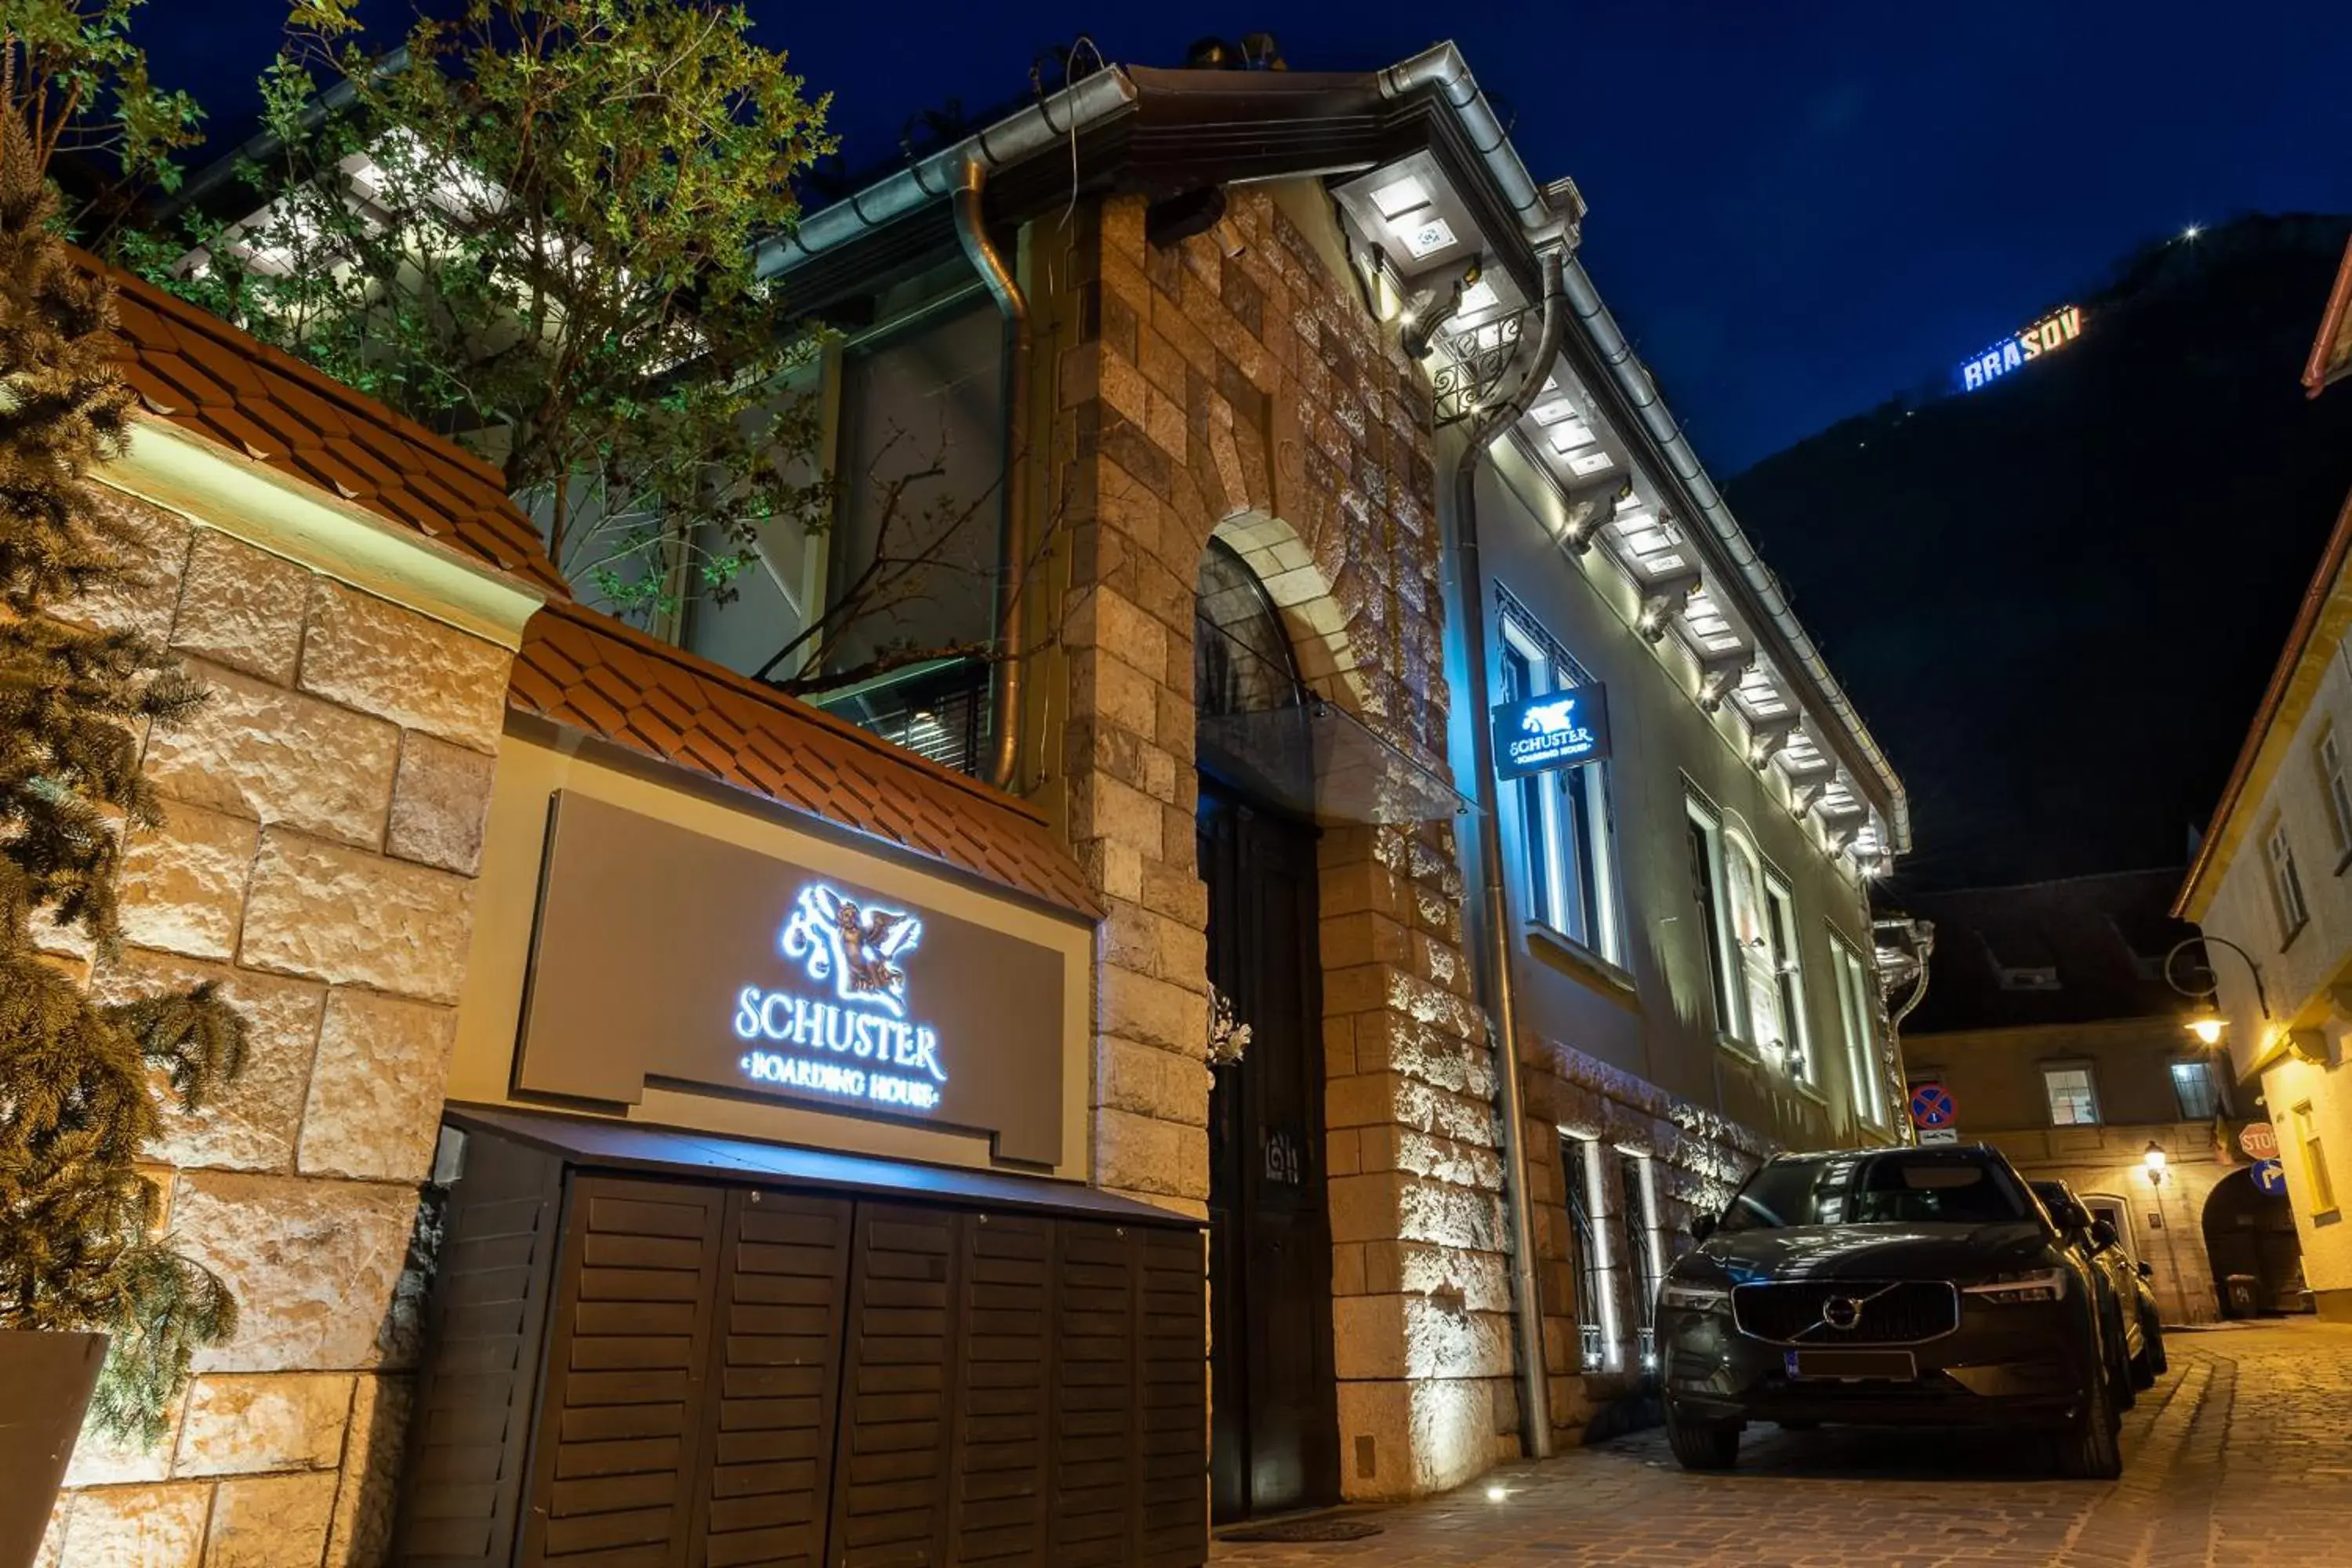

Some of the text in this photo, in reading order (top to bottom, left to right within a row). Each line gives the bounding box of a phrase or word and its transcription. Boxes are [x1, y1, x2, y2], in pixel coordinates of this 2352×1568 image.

[1509, 727, 1593, 757] SCHUSTER
[735, 986, 947, 1080] SCHUSTER
[750, 1051, 866, 1095] BOARDING
